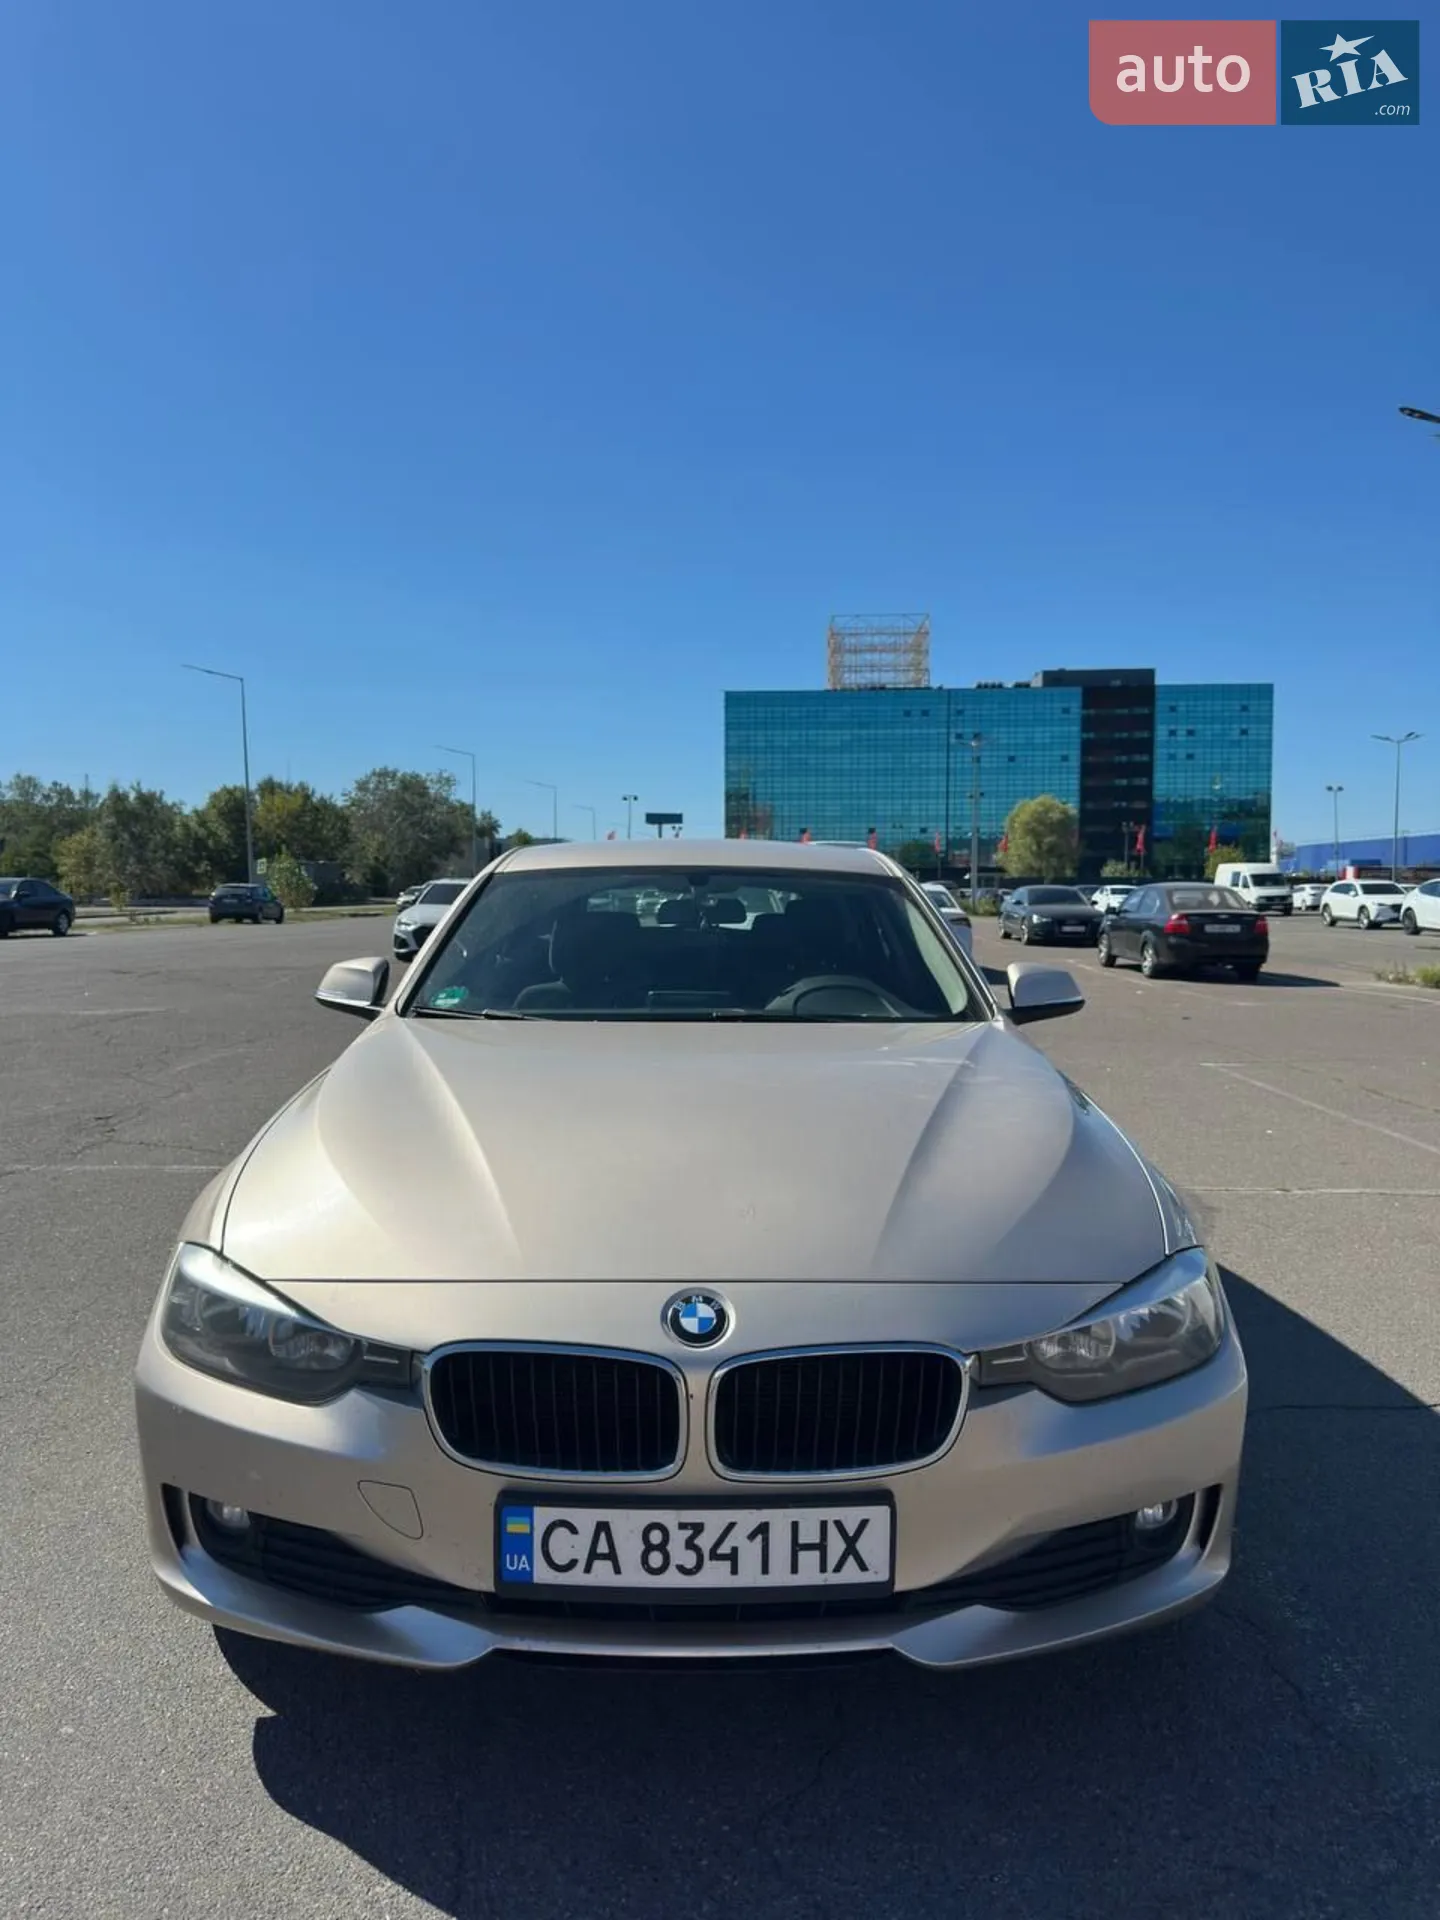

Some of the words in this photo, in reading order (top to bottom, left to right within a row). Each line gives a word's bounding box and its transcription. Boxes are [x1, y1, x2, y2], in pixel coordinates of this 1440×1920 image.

[674, 1295, 722, 1311] BMW
[540, 1518, 622, 1575] CA
[639, 1520, 770, 1576] 8341
[790, 1517, 870, 1574] HX
[506, 1553, 530, 1571] UA
